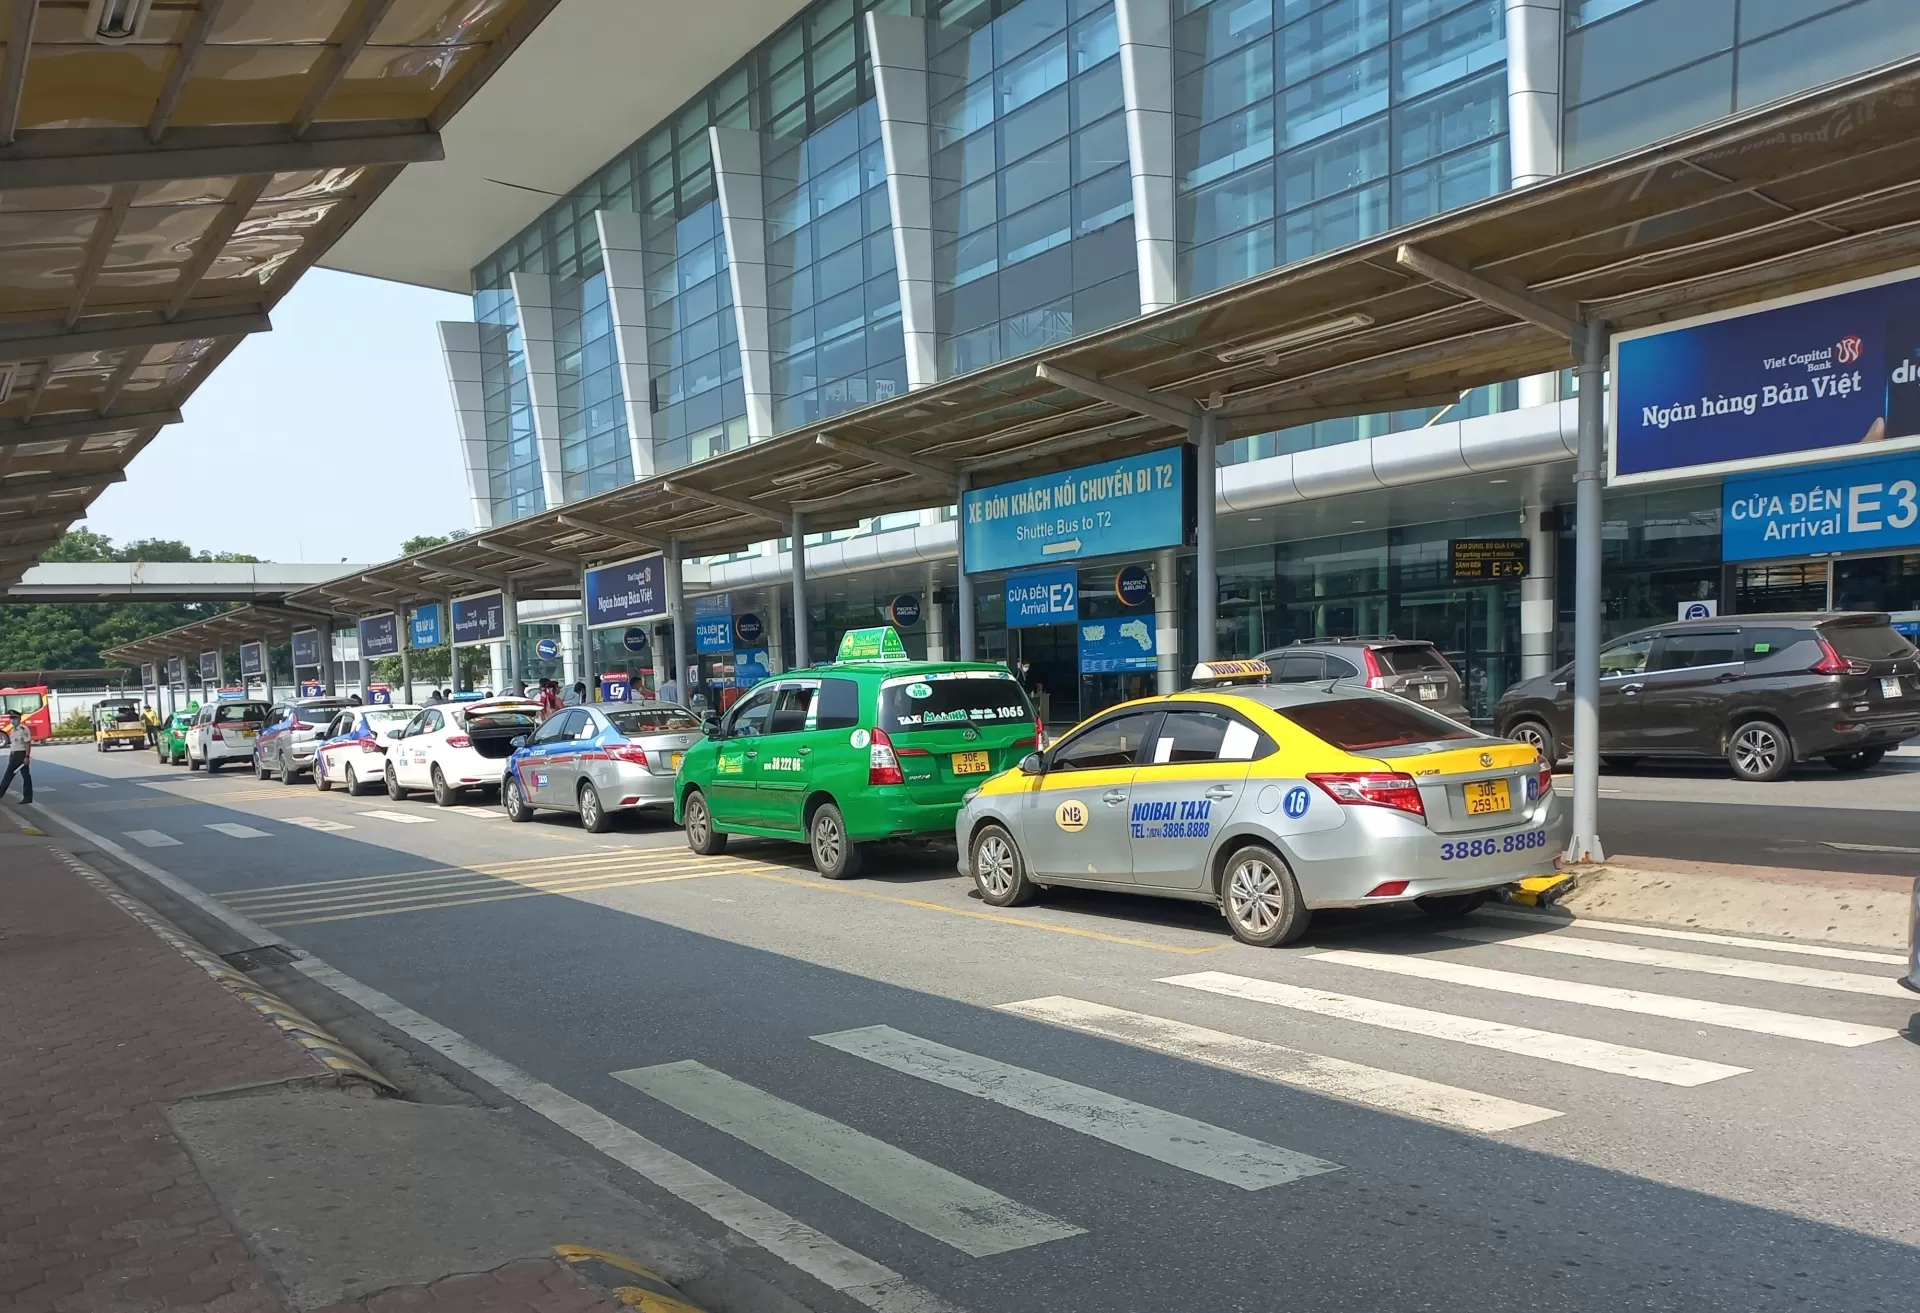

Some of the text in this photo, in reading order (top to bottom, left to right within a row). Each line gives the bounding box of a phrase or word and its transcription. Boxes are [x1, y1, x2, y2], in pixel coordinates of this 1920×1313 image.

[1763, 347, 1832, 371] Viet Capital
[1807, 361, 1832, 372] Bank
[1892, 359, 1920, 386] di
[1642, 371, 1862, 429] Ngân hàng Bản Việt
[968, 464, 1173, 524] XE ĐÓN KHÁCH NỐI CHUYẾN ĐI T2
[1731, 480, 1918, 533] CỬA ĐẾN E3
[1016, 511, 1112, 541] Shuttle Bus to T2
[1764, 513, 1841, 541] Arrival
[1492, 562, 1500, 576] E
[1008, 583, 1074, 613] CỬA ĐẾN E2
[1020, 600, 1048, 616] Arrival
[718, 624, 730, 644] E1
[1207, 662, 1246, 676] NOIBAI
[997, 706, 1024, 718] 1055
[1478, 780, 1496, 797] 30E
[1131, 800, 1212, 822] NOIBAI TAXI
[1290, 791, 1305, 813] 16
[1472, 796, 1506, 812] 259.11
[1062, 806, 1082, 822] NB
[1162, 822, 1210, 838] 3886.8888
[1440, 830, 1546, 861] 3886.8888
